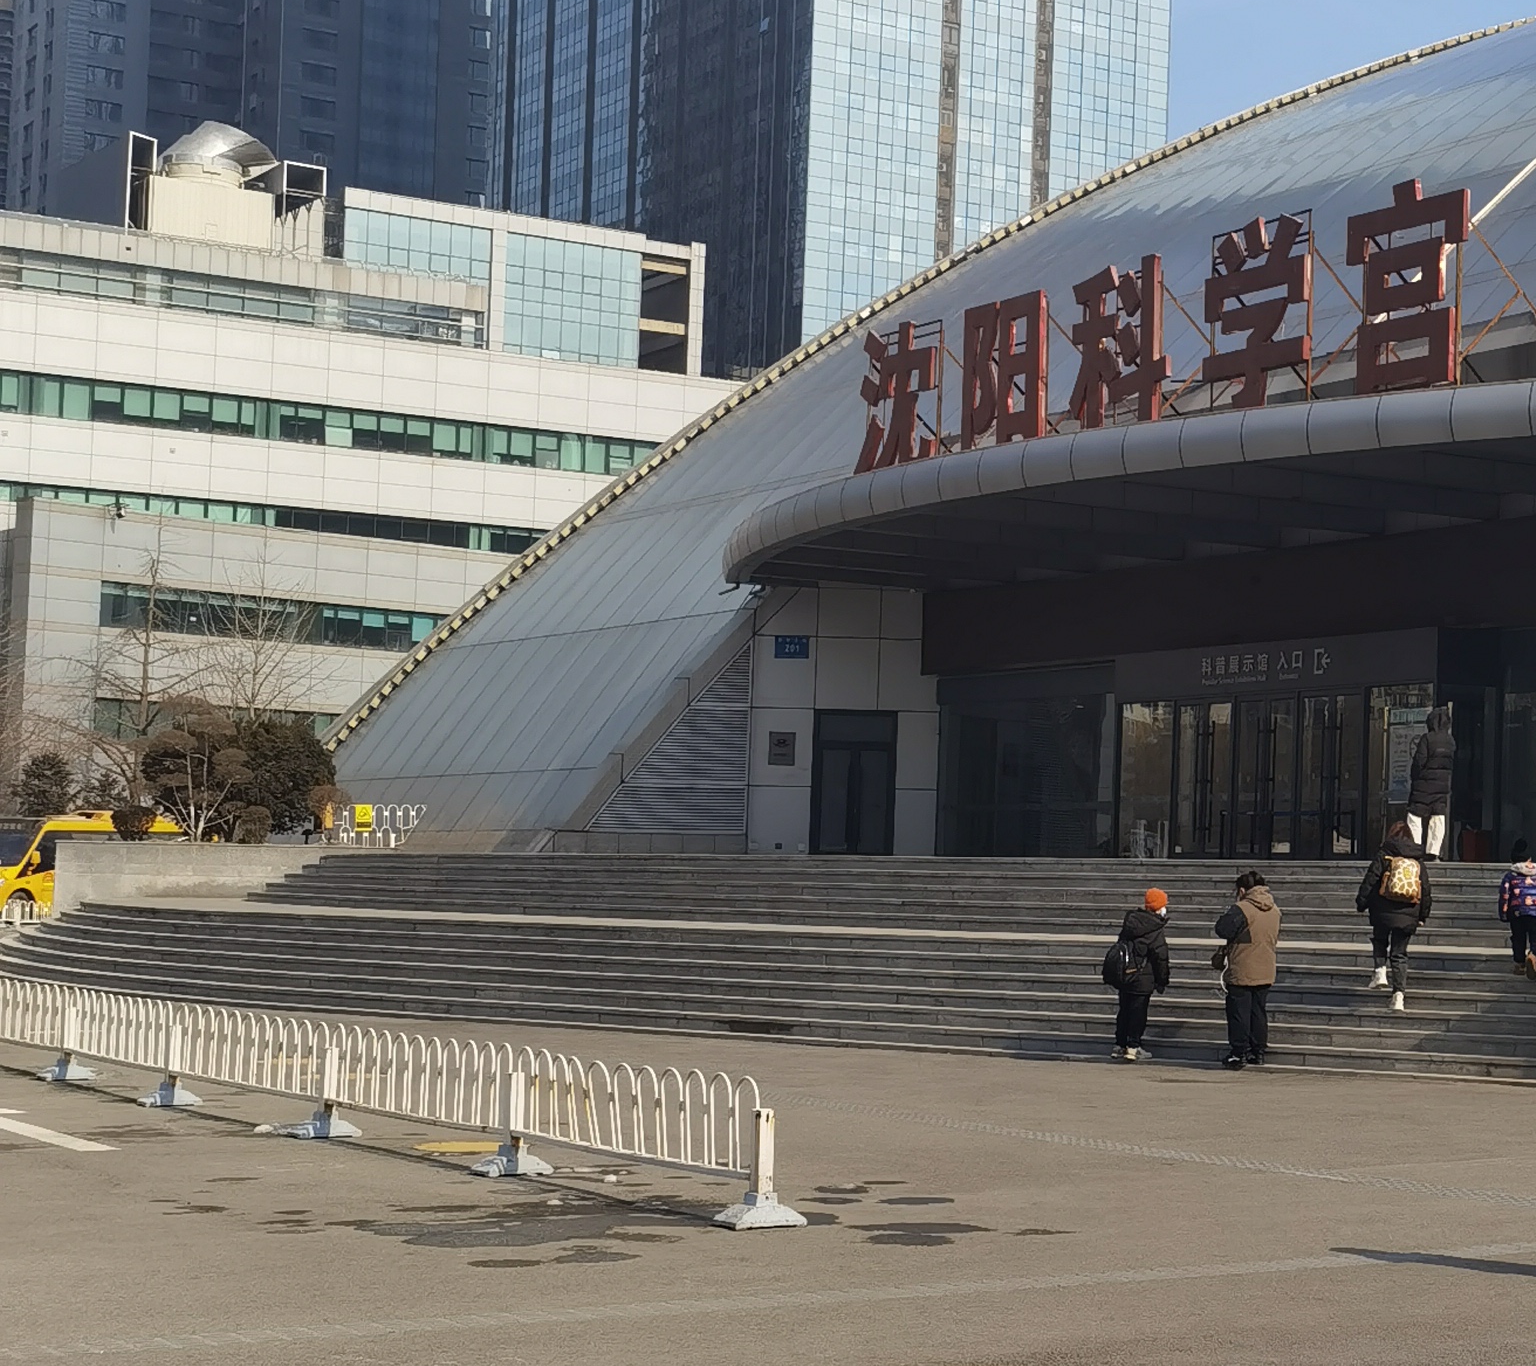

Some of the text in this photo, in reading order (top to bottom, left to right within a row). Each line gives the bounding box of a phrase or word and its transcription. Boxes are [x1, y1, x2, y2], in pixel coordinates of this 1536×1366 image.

[853, 177, 1472, 475] 沈阳科学宫
[1201, 650, 1303, 676] 科普展示馆 入口
